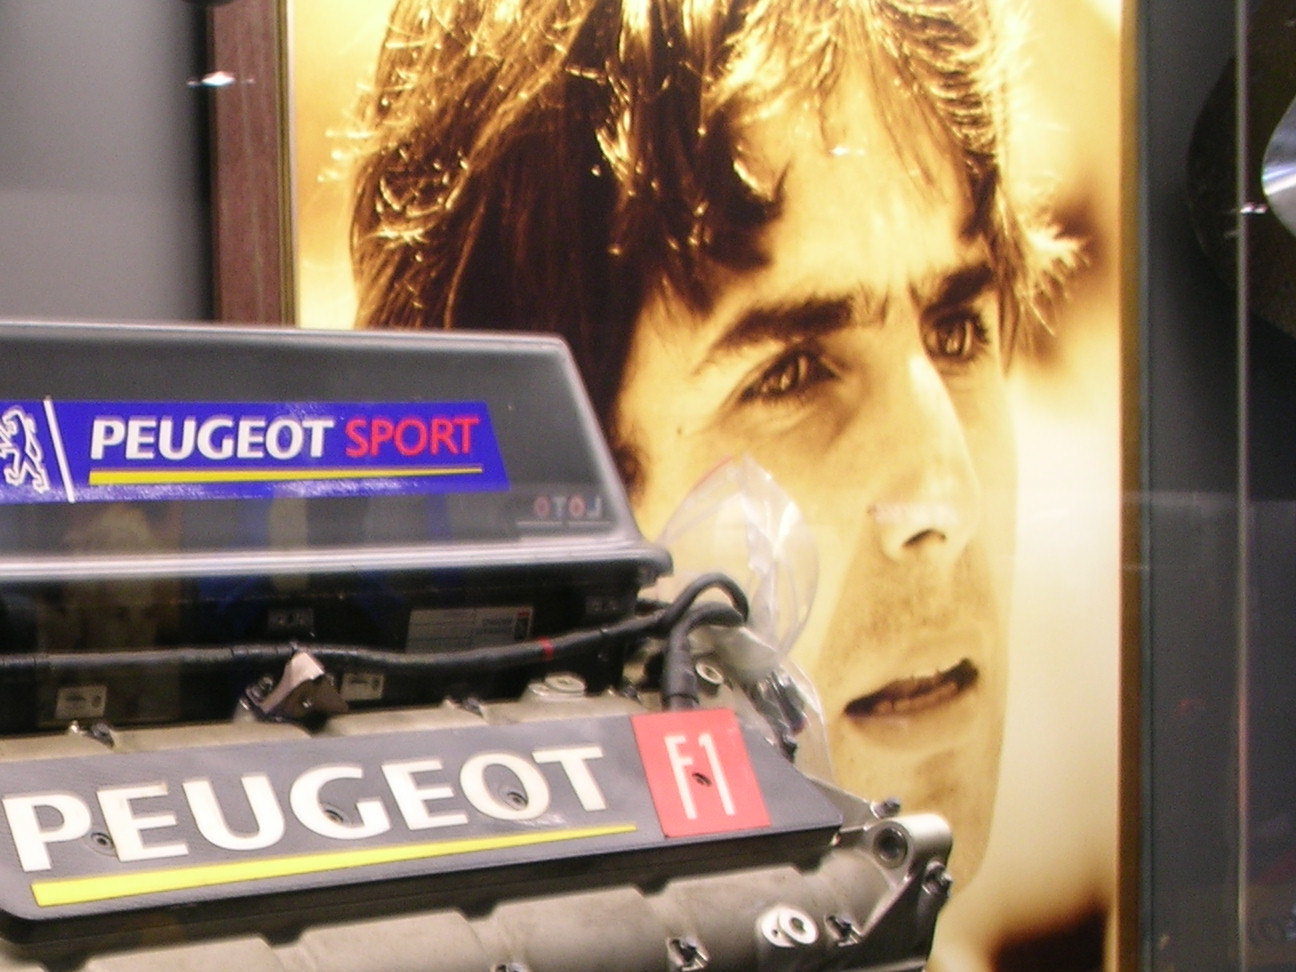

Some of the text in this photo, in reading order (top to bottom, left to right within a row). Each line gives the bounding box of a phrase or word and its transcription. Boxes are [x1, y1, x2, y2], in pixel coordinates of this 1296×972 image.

[90, 417, 479, 459] PEUGEOT SPORT
[2, 733, 736, 872] PEUGEOT F1
